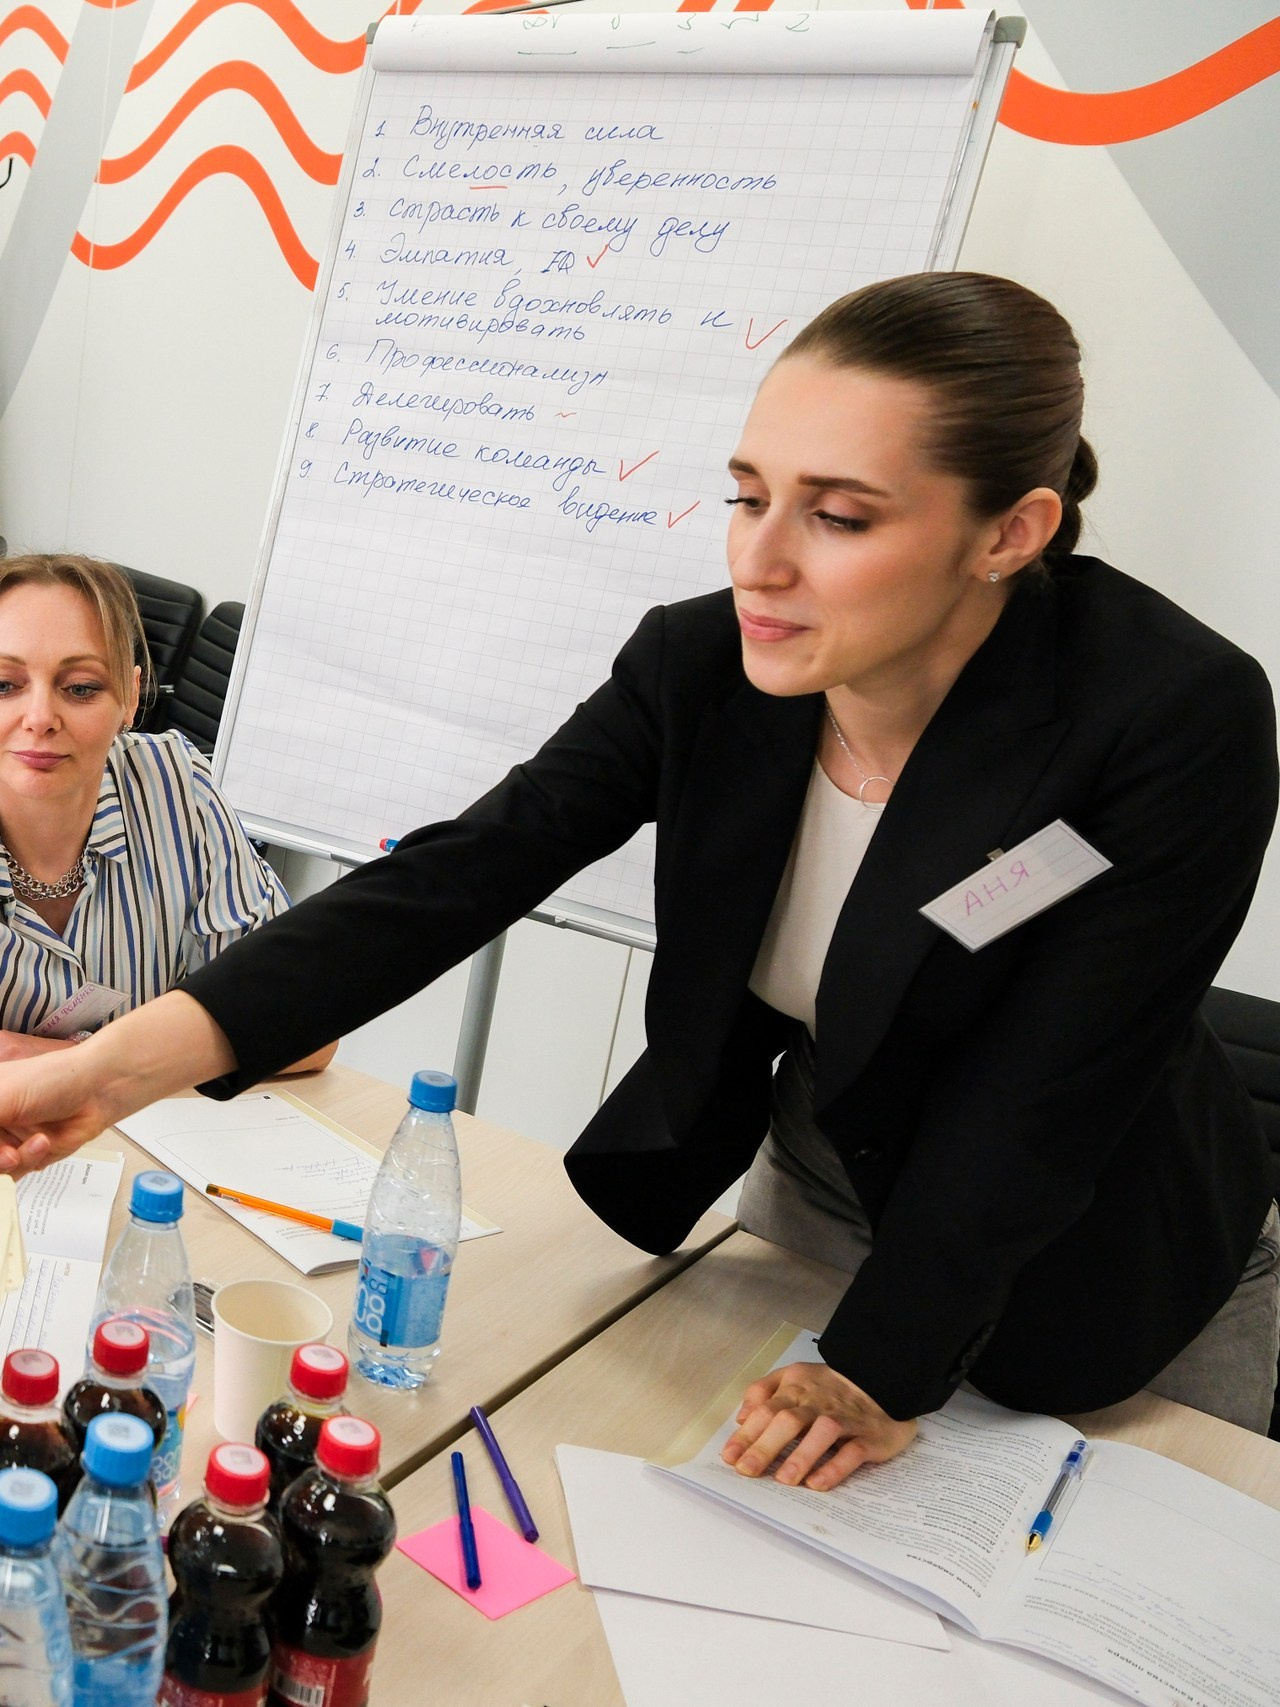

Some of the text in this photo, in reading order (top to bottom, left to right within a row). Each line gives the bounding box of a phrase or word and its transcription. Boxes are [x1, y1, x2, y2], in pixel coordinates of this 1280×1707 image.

[409, 104, 565, 151] Внутренняя
[584, 124, 664, 141] сила
[582, 159, 777, 196] уверенность
[510, 209, 532, 228] к
[542, 203, 639, 252] своему
[649, 217, 731, 257] делу
[375, 312, 586, 344] мотивировать
[376, 279, 478, 306] Умение
[493, 278, 672, 324] вдохновлять
[700, 310, 733, 328] и
[351, 381, 535, 422] Делегировать
[341, 418, 461, 461] Развитие
[474, 445, 607, 492] команды
[333, 461, 531, 509] Стратегическое
[558, 485, 658, 534] видение
[964, 860, 1030, 916] АНЯ
